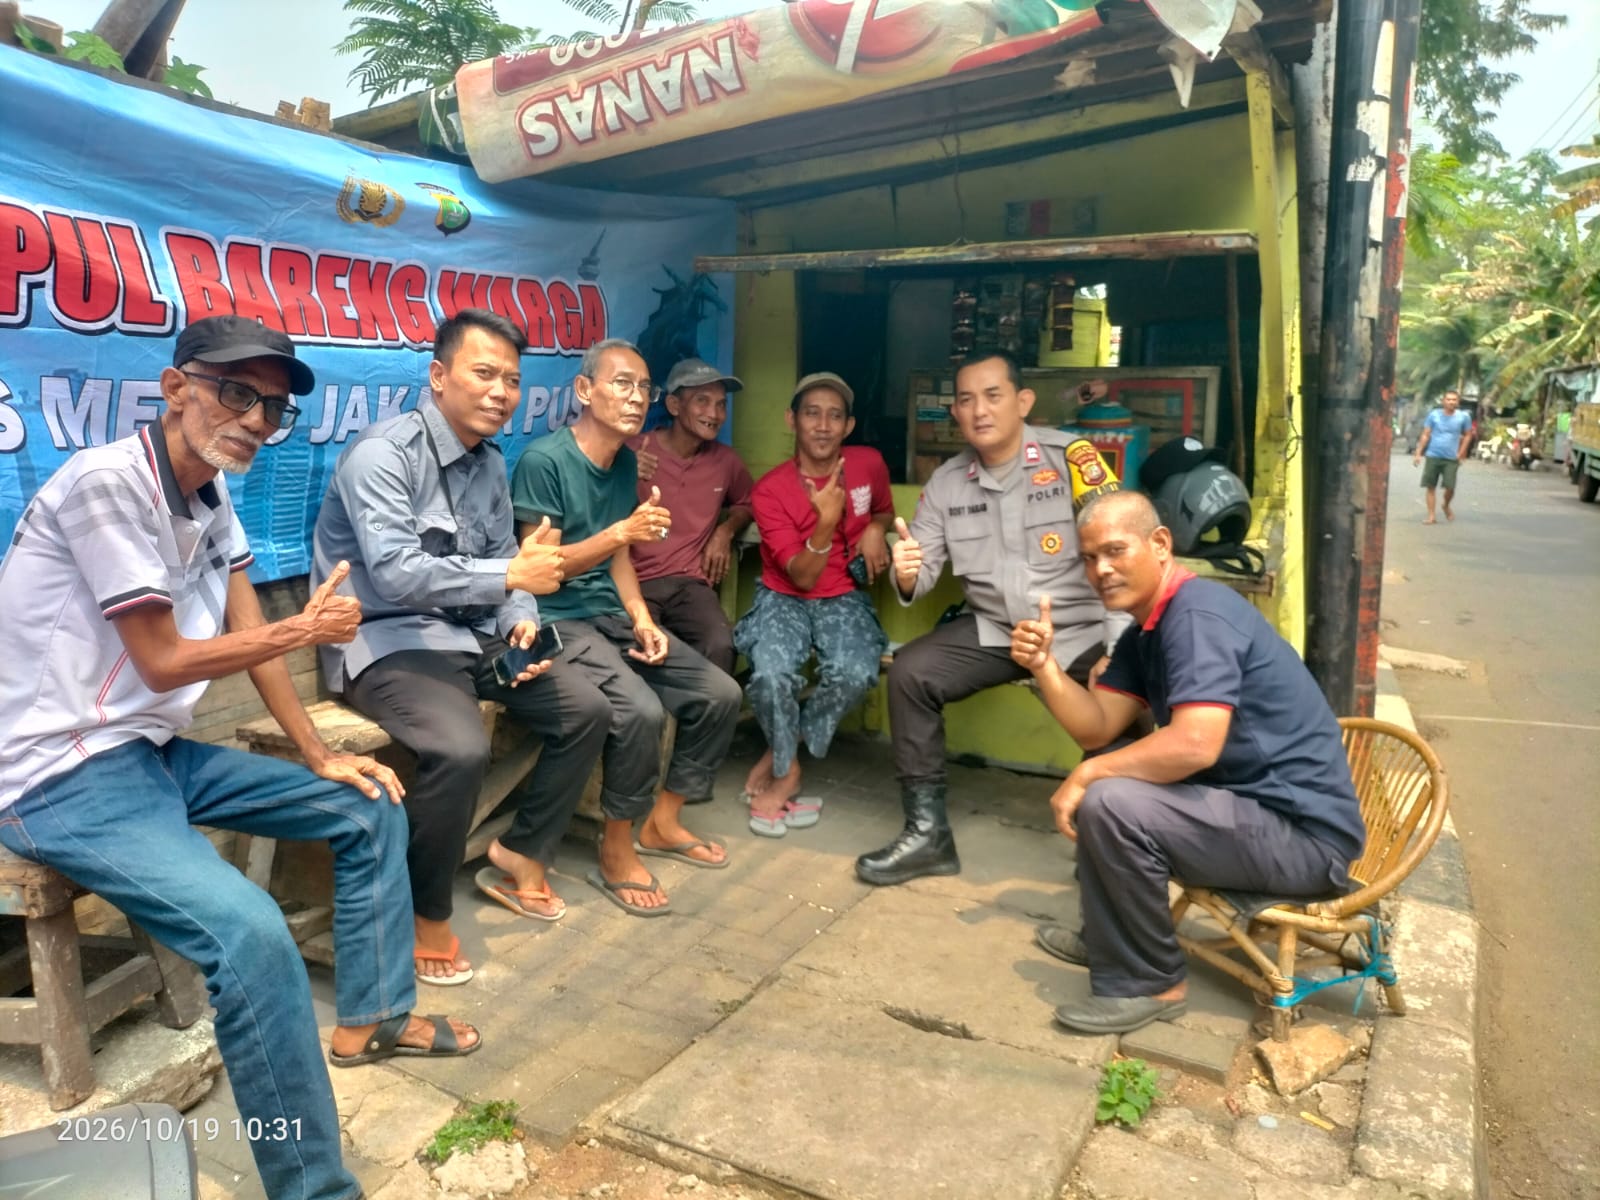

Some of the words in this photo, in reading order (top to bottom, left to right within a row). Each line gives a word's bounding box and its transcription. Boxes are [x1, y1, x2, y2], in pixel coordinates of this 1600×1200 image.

[516, 30, 746, 157] NANAS
[163, 228, 436, 347] BARENG
[437, 269, 607, 353] WARGA
[523, 386, 585, 434] PUS
[1027, 486, 1066, 504] POLRI
